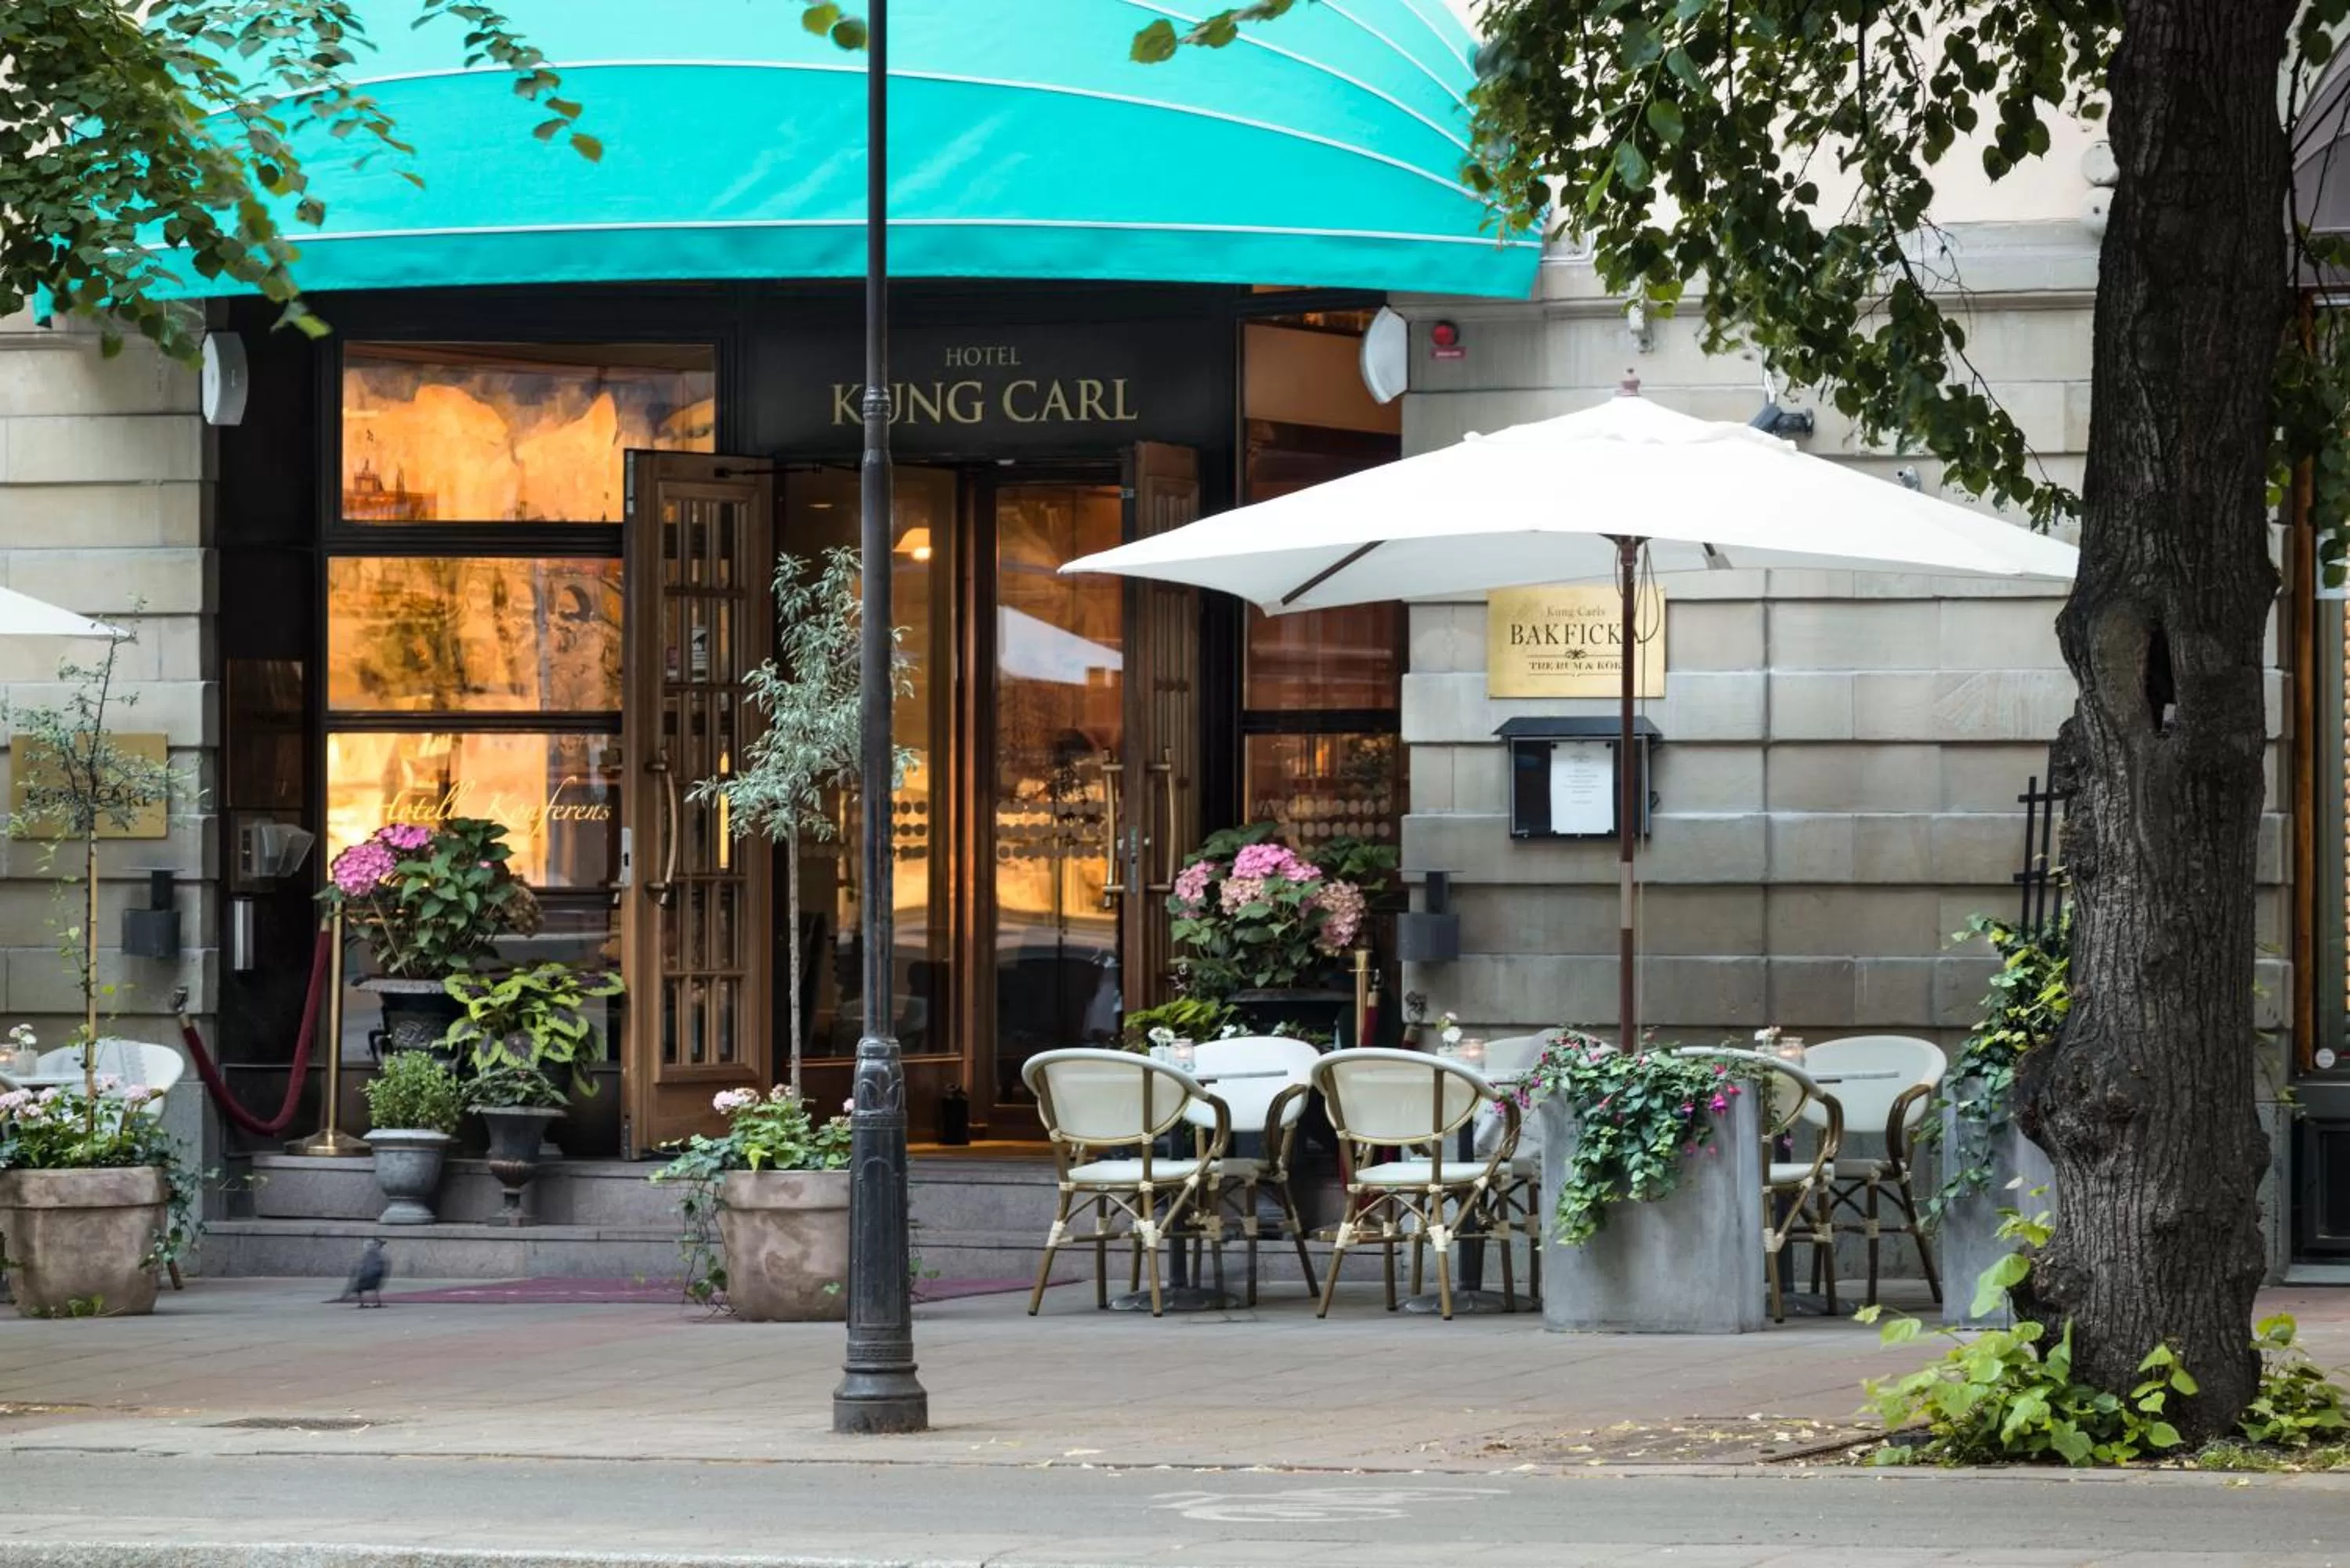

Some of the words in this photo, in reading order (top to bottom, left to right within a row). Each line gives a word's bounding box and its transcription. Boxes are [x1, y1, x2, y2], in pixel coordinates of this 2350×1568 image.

[945, 346, 1021, 367] HOTEL
[830, 381, 985, 425] KUNG
[1003, 378, 1138, 423] CARL
[1546, 605, 1574, 620] Kung
[1577, 605, 1606, 617] Carls
[1510, 623, 1643, 645] BAKFICK
